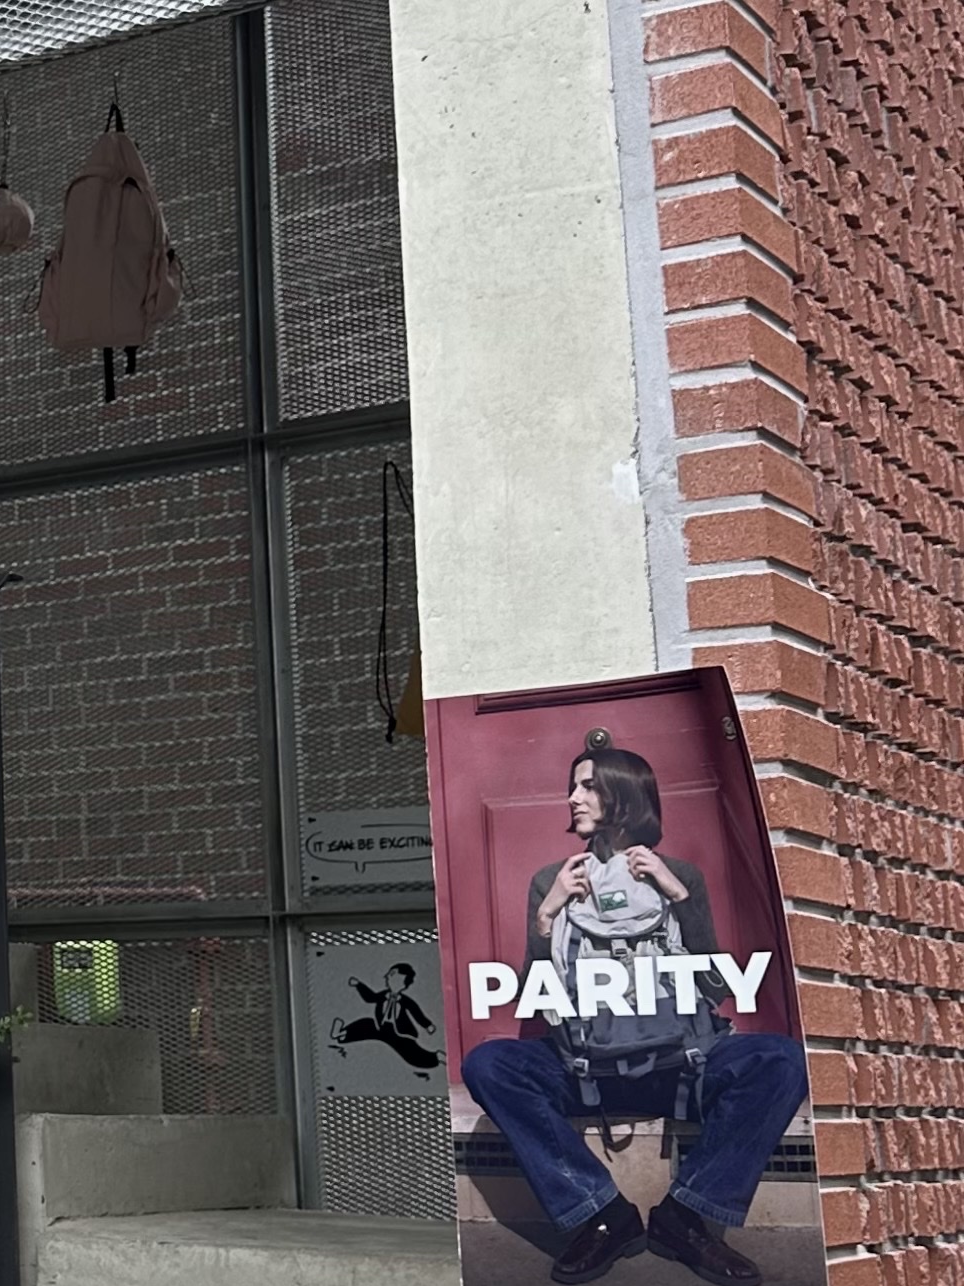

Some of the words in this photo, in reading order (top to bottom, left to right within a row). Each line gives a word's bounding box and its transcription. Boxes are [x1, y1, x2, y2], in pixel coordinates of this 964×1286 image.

[313, 841, 324, 853] IT
[357, 838, 374, 850] BE
[468, 951, 772, 1020] PARITY
